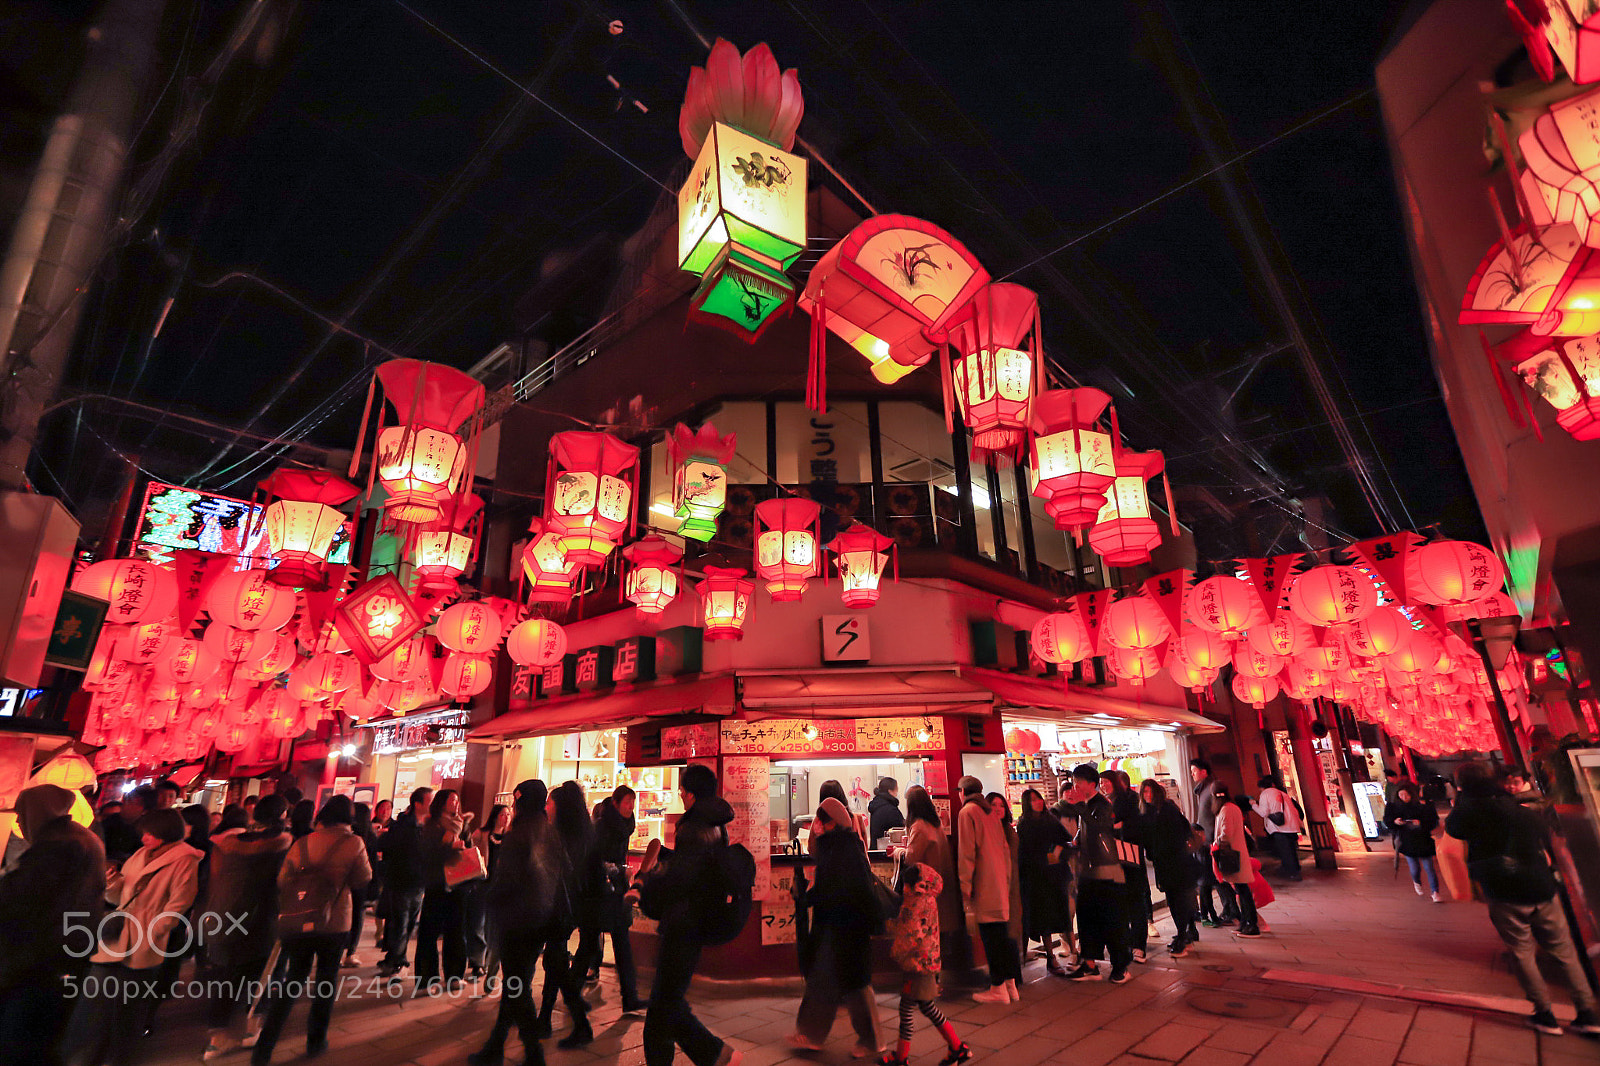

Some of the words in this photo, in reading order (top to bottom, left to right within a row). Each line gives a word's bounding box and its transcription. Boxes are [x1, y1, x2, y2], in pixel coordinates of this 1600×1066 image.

[1464, 543, 1489, 591] 長崎燈會
[117, 564, 149, 615] 長崎燈會
[1201, 582, 1221, 625] 長崎燈會
[1335, 568, 1360, 614] 長崎燈會
[464, 605, 483, 646] 長崎燈會
[543, 622, 559, 659] 長崎燈會
[780, 742, 811, 752] ¥250
[825, 742, 855, 752] ¥300
